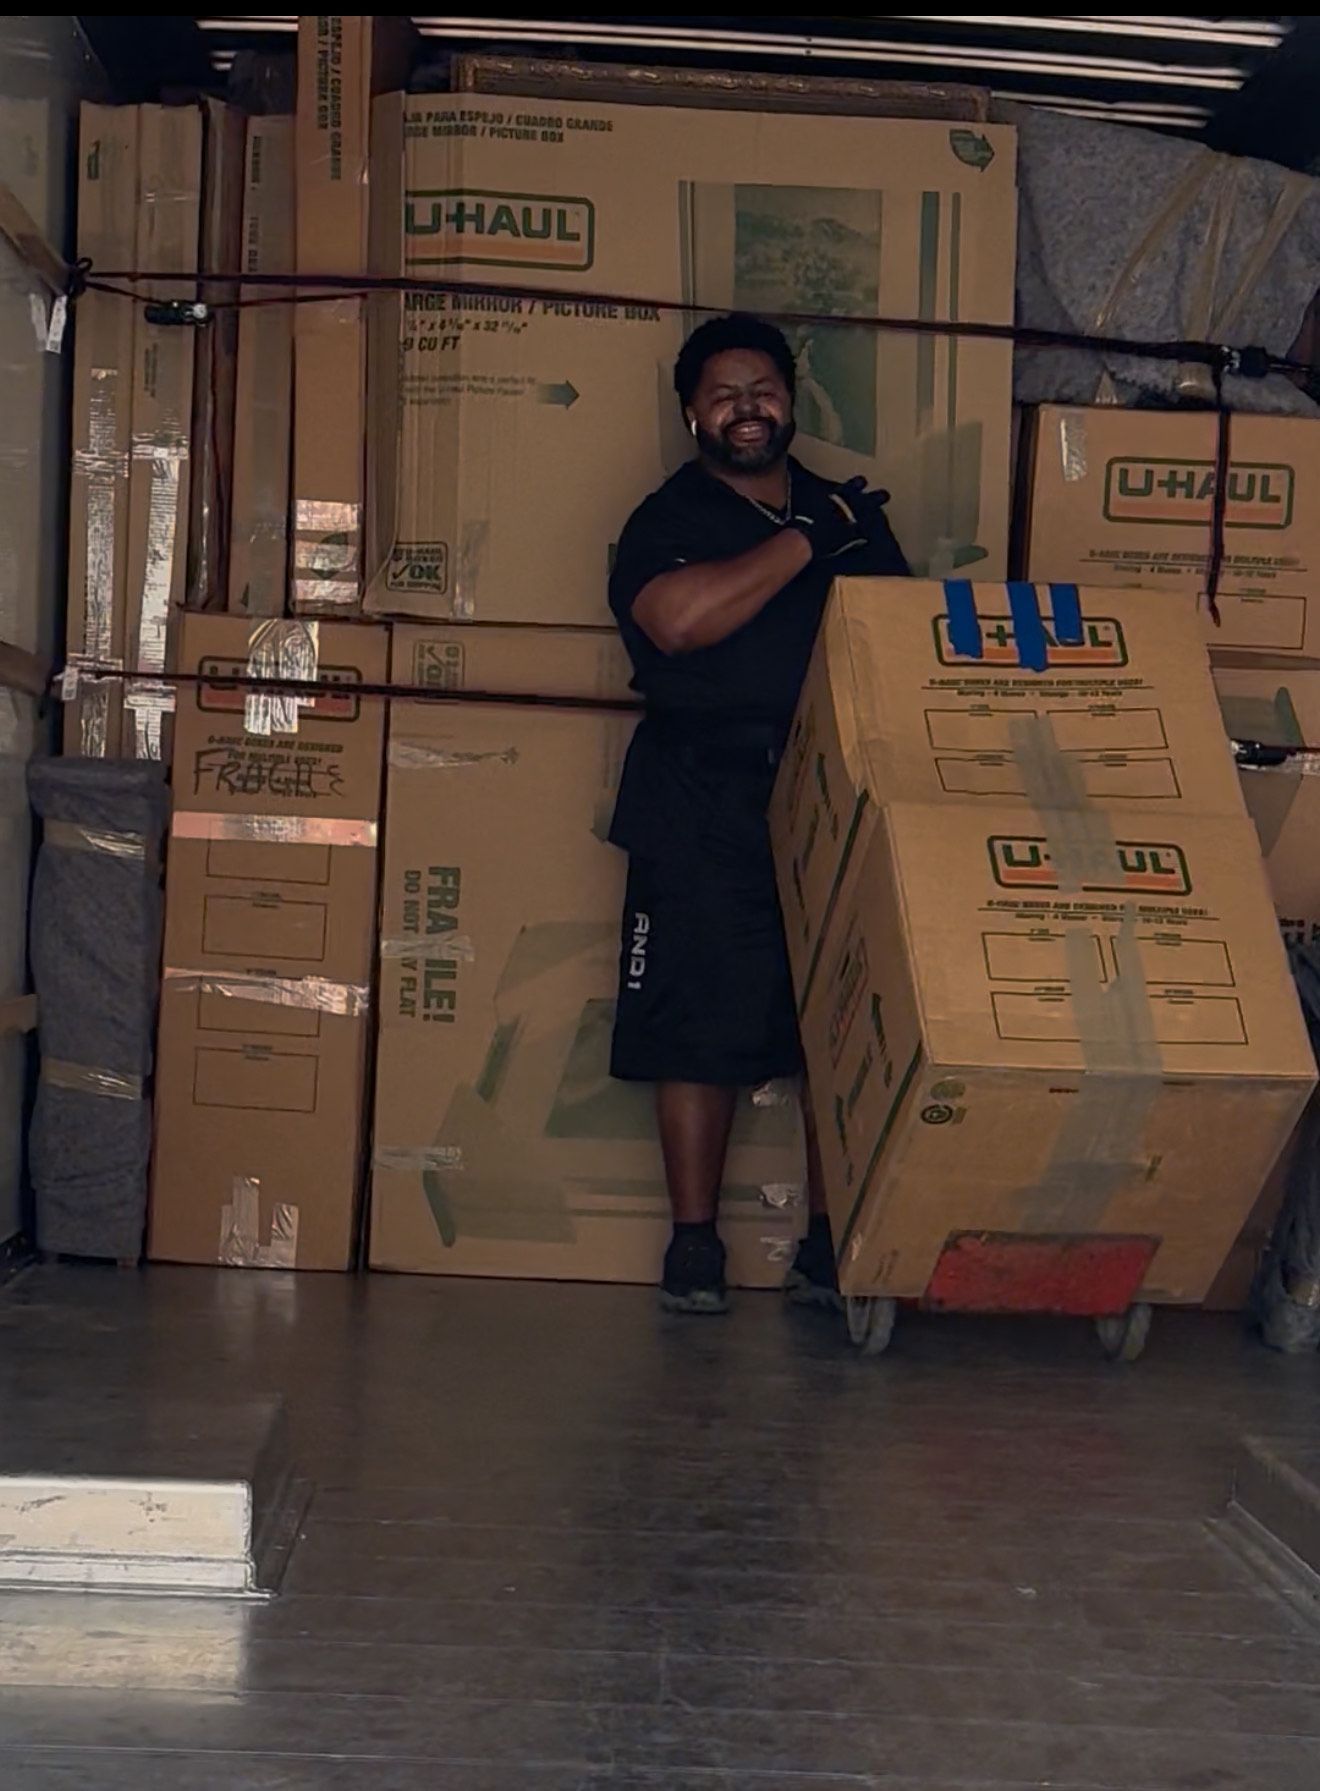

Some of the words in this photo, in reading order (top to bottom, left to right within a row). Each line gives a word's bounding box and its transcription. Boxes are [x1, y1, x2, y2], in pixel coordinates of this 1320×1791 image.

[426, 111, 456, 123] PARA
[460, 110, 504, 125] ESPEJO
[516, 114, 563, 129] CUADRO
[566, 117, 614, 131] GRANDE
[432, 125, 477, 138] MIRROR
[489, 126, 538, 141] PICTURE
[541, 129, 564, 142] BOX
[404, 202, 580, 242] U-HAUL
[452, 295, 523, 314] MIRROR
[542, 301, 618, 319] PICTURE
[625, 304, 661, 321] BOX
[418, 337, 438, 351] CU
[441, 336, 460, 350] FT
[409, 564, 442, 580] OK
[1002, 844, 1176, 875] U-UL
[404, 869, 422, 894] DO
[403, 900, 421, 934] NOT
[423, 866, 461, 1024] FRAILE!
[399, 977, 417, 1019] FLAT
